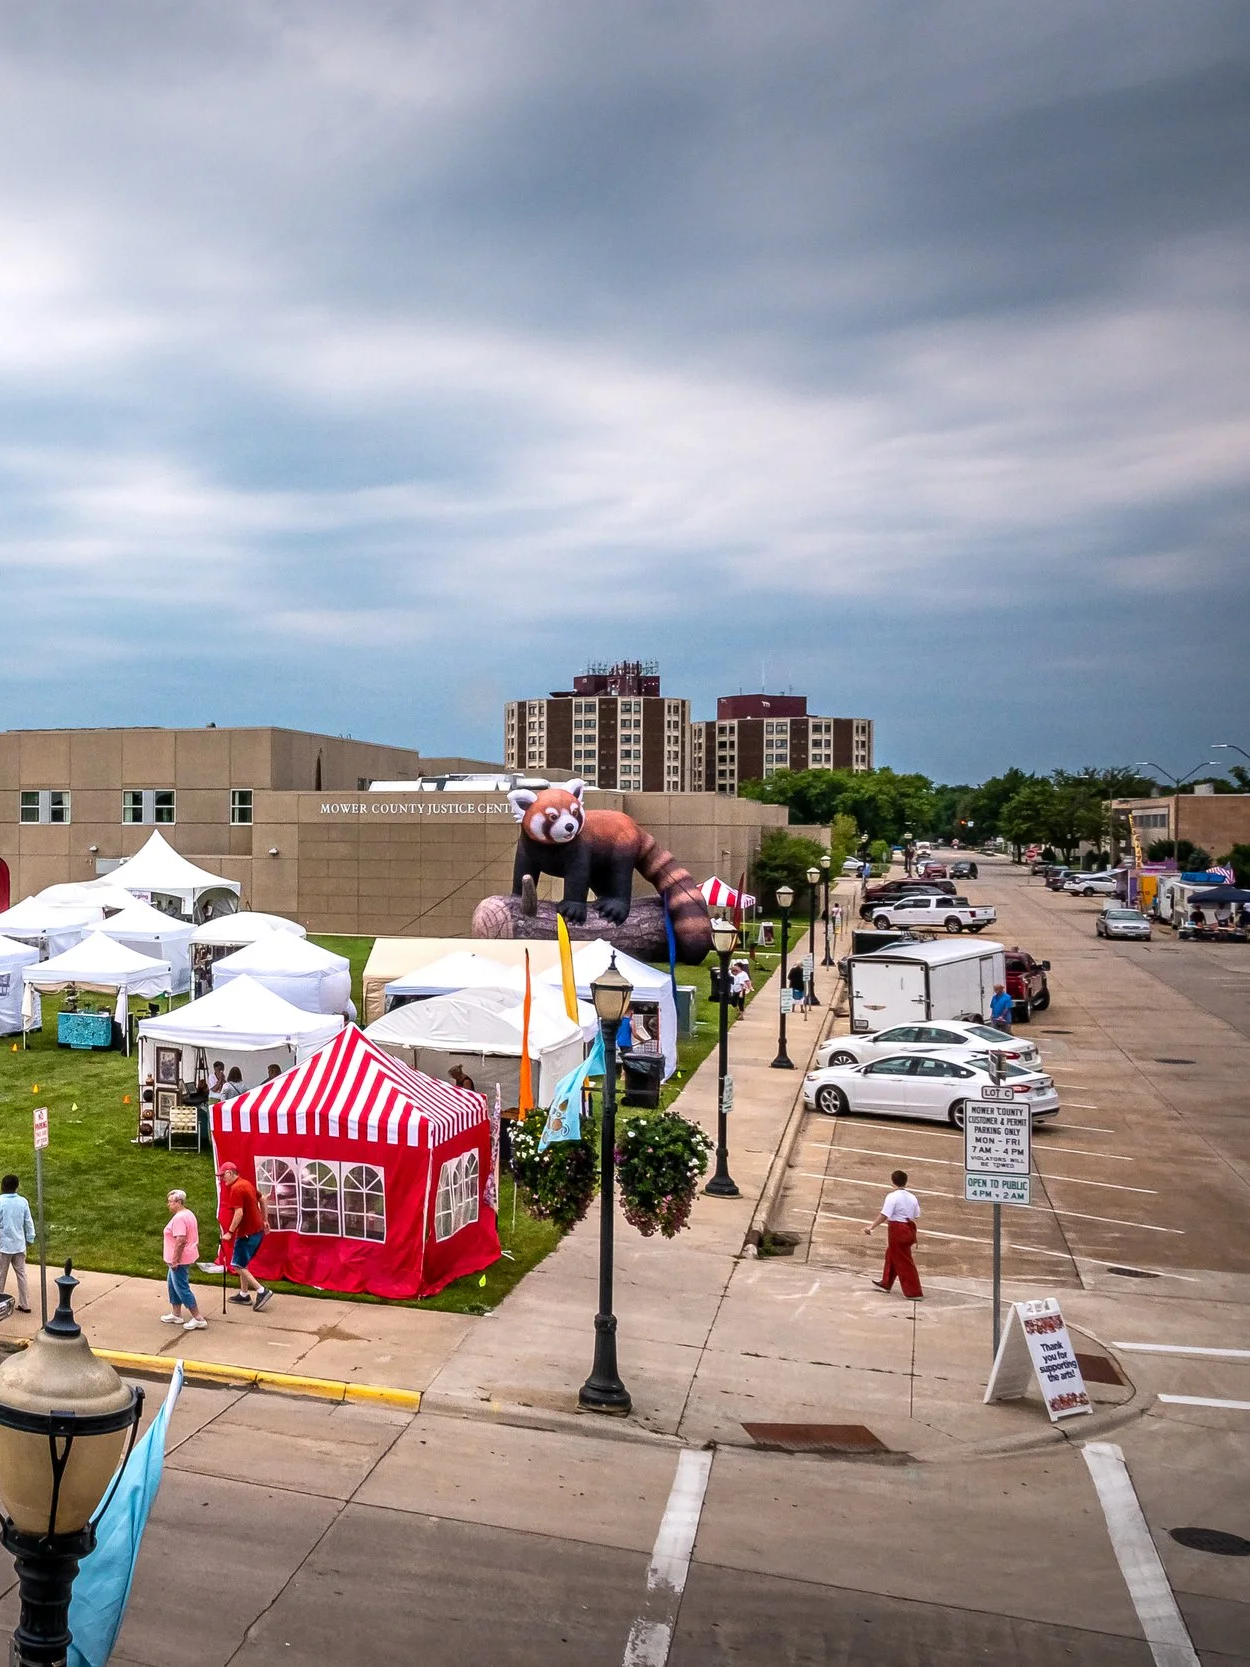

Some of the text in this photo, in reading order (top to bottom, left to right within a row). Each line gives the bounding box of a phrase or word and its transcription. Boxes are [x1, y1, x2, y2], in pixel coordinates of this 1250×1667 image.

[320, 803, 516, 815] MOWER COUNTY JUSTICE CENT
[985, 1089, 1000, 1098] LOT
[972, 1106, 1023, 1117] MOWER COUNTY
[968, 1116, 998, 1126] CUSTOMER
[1006, 1118, 1026, 1126] PERMIT
[974, 1126, 1020, 1136] PARKING ONLY
[1006, 1138, 1020, 1146] FRI
[978, 1146, 992, 1154] AM
[968, 1178, 1028, 1190] OPEN TO PUBLIC
[1040, 1340, 1064, 1352] Thank
[1042, 1351, 1067, 1364] you for
[1040, 1360, 1078, 1374] supporting
[1047, 1370, 1076, 1382] the arts!
